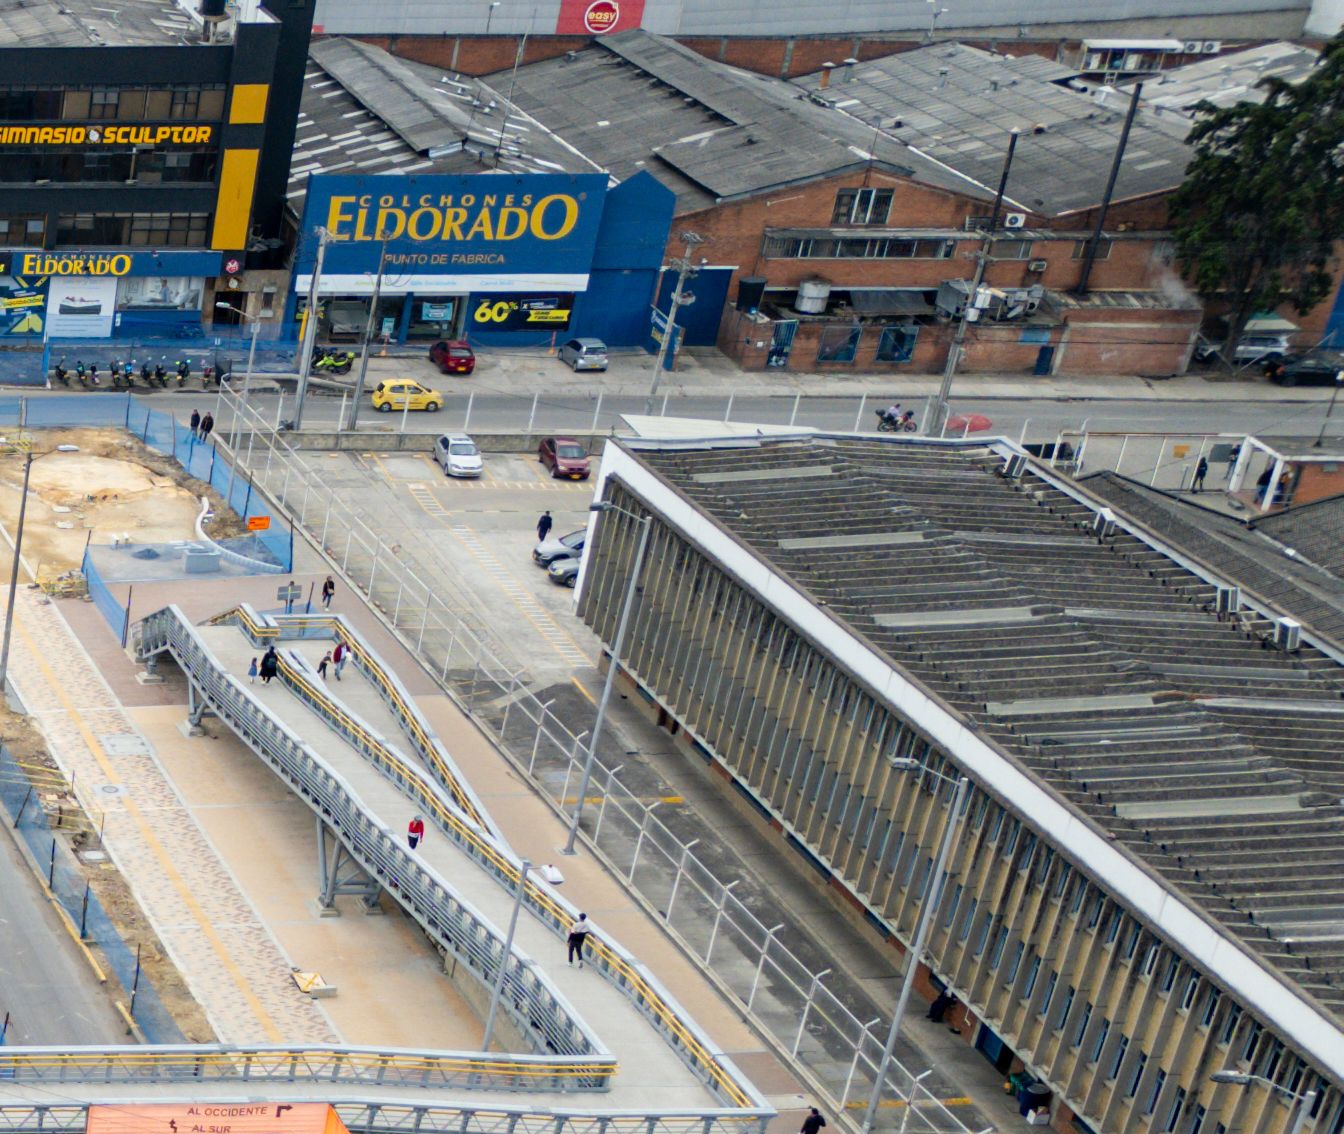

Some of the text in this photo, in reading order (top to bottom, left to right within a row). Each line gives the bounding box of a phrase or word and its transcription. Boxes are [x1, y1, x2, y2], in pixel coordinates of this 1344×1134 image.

[587, 11, 616, 22] easy
[102, 126, 211, 144] SCULPTOR
[359, 194, 533, 207] COLCHONES
[326, 193, 579, 241] ELDORADO
[22, 254, 132, 276] ELDORADO
[385, 253, 506, 265] PUNTO DE FABRICA
[474, 300, 518, 323] 60%
[186, 1106, 269, 1117] AL OCCIDENTE
[191, 1124, 232, 1134] AL SUR
